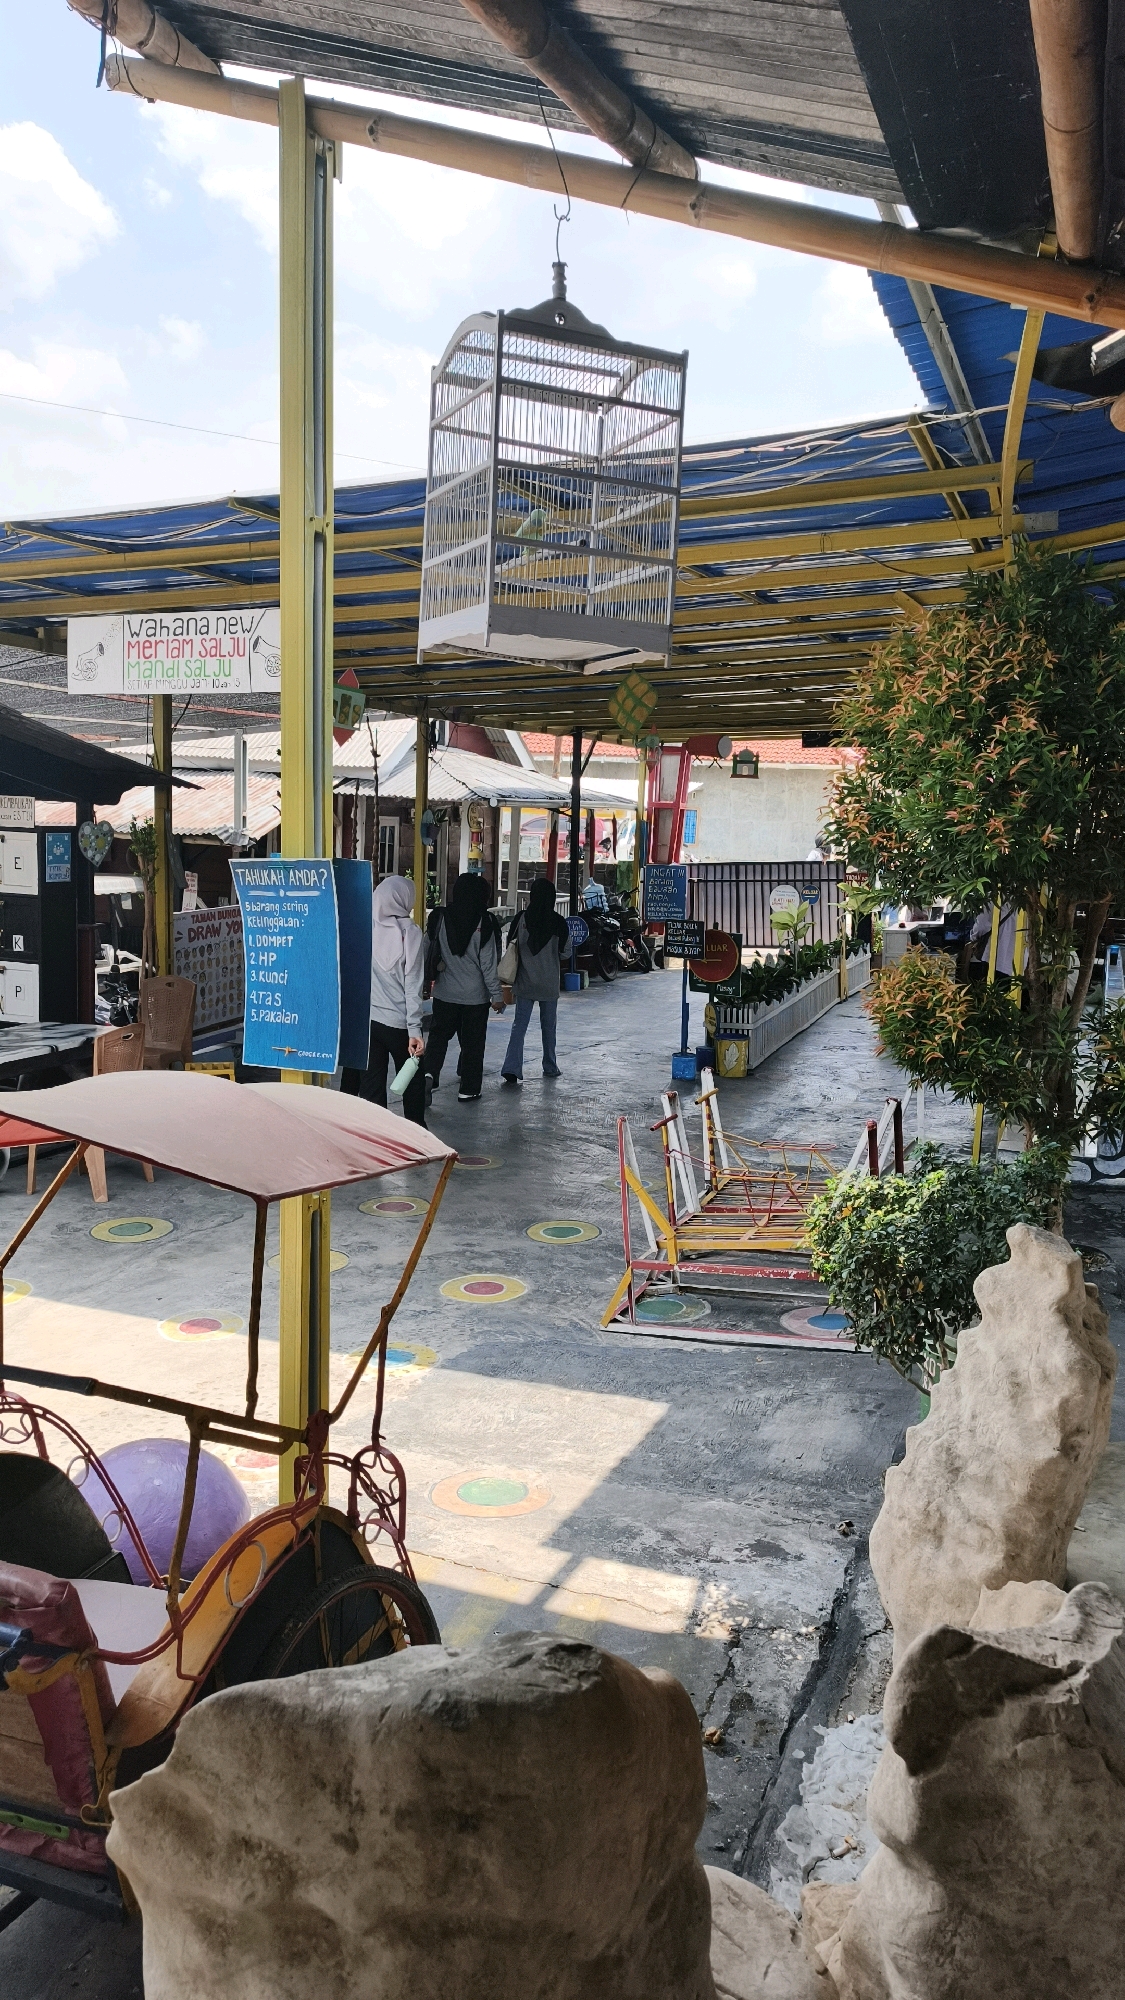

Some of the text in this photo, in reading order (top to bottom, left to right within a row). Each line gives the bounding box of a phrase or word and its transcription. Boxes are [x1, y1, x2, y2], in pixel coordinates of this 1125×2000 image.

[14, 856, 22, 870] E
[235, 868, 328, 890] TAHUKAH ANDA?
[187, 921, 222, 943] DRAW
[14, 936, 22, 950] K
[258, 951, 277, 967] HP
[15, 985, 23, 998] P
